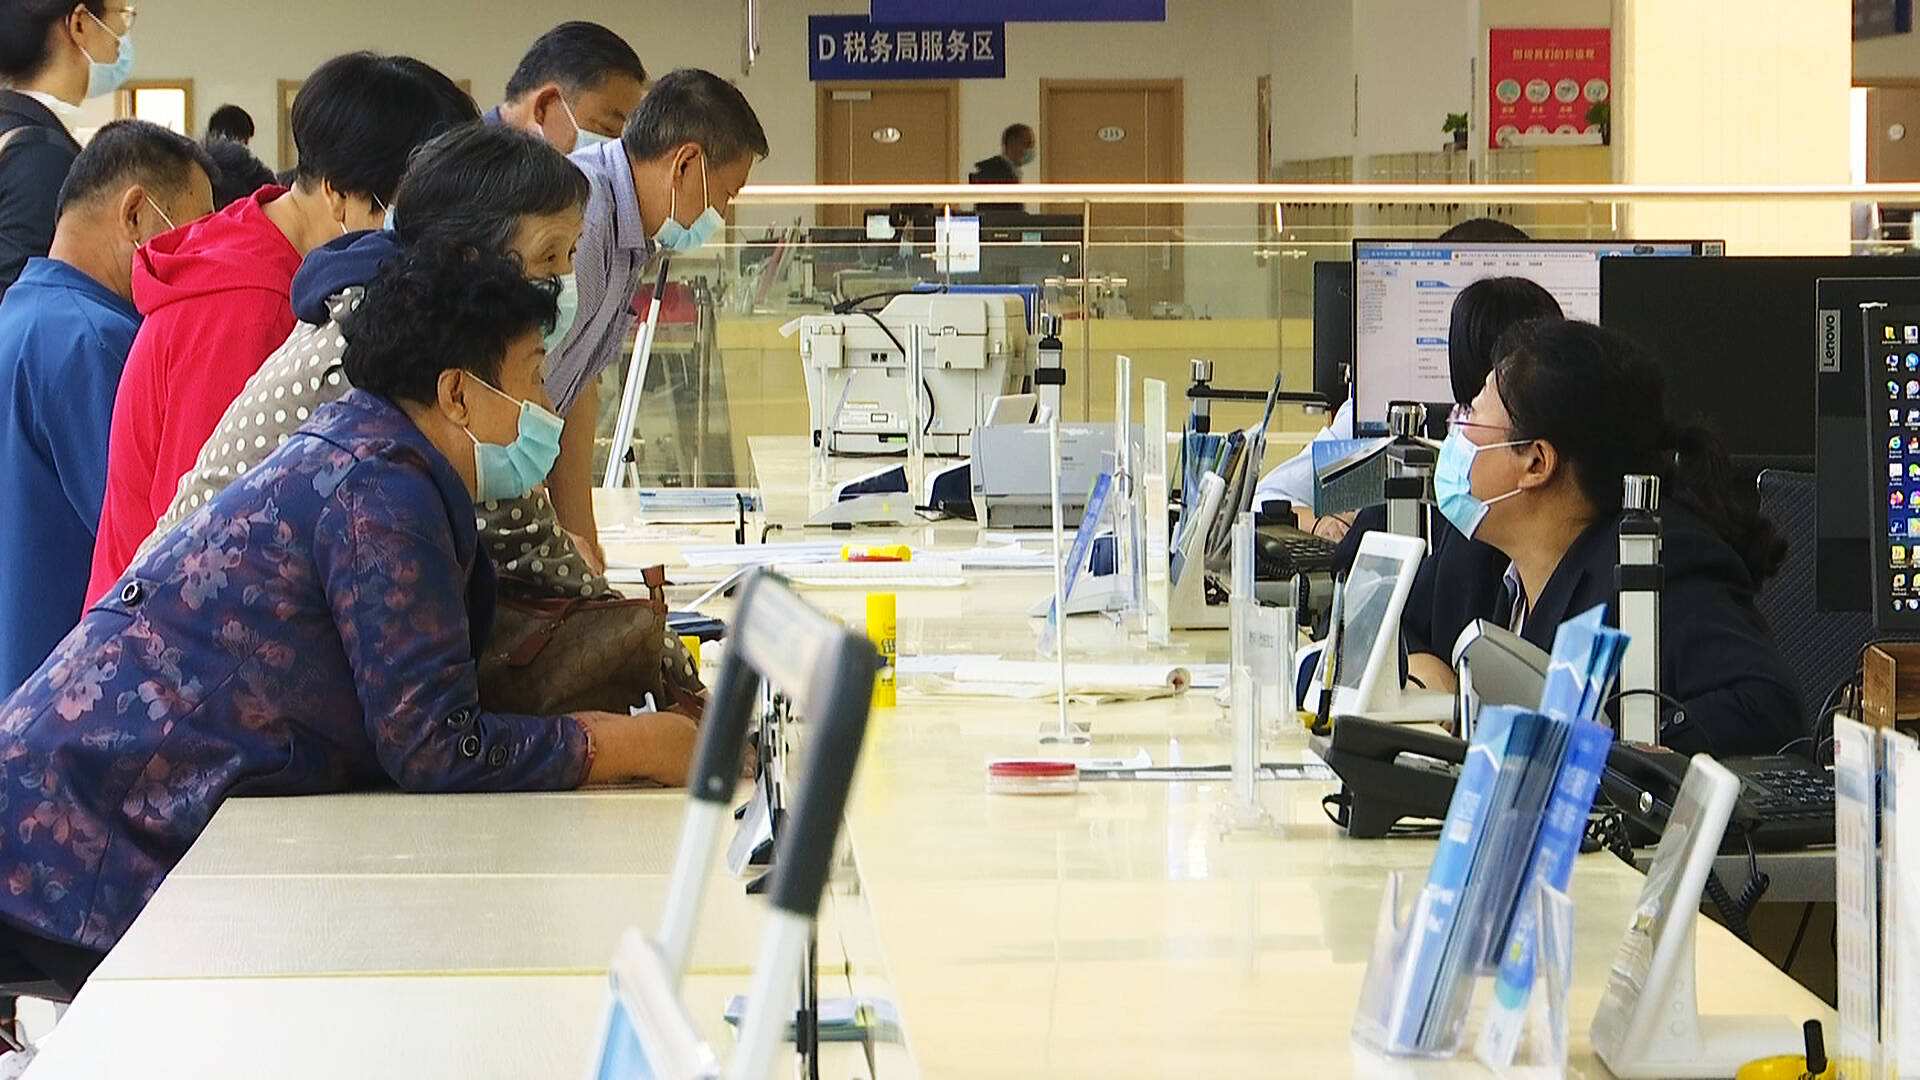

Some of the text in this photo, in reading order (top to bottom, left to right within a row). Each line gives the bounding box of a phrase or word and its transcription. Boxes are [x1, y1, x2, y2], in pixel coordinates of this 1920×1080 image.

[818, 30, 995, 63] D 税务局服务区
[1824, 315, 1836, 367] Lenovo
